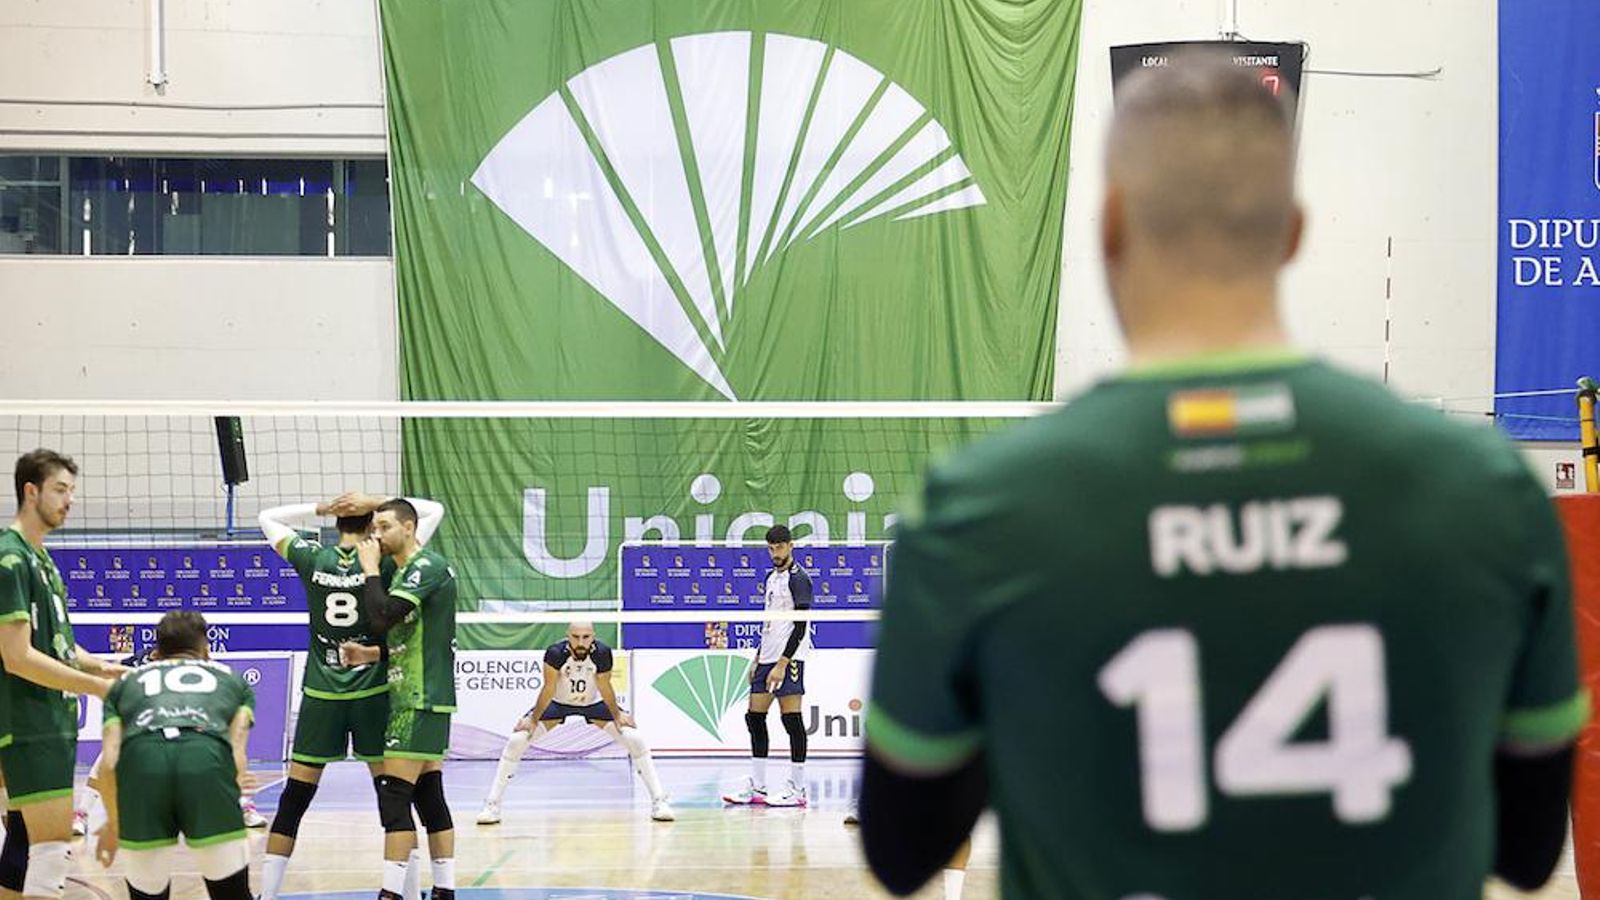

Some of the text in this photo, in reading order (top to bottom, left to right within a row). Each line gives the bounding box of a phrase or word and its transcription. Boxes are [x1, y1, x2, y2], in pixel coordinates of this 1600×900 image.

[1142, 57, 1169, 66] LOCAL
[1232, 56, 1279, 66] VISITANTE
[1508, 219, 1600, 249] DIPU
[1512, 257, 1563, 286] DE
[1149, 497, 1347, 576] RUIZ
[325, 592, 359, 627] 8
[137, 665, 218, 696] 10
[456, 660, 542, 674] IOLENCIA
[467, 673, 542, 690] GÉNERO
[570, 679, 586, 693] 10
[1097, 624, 1413, 832] 14
